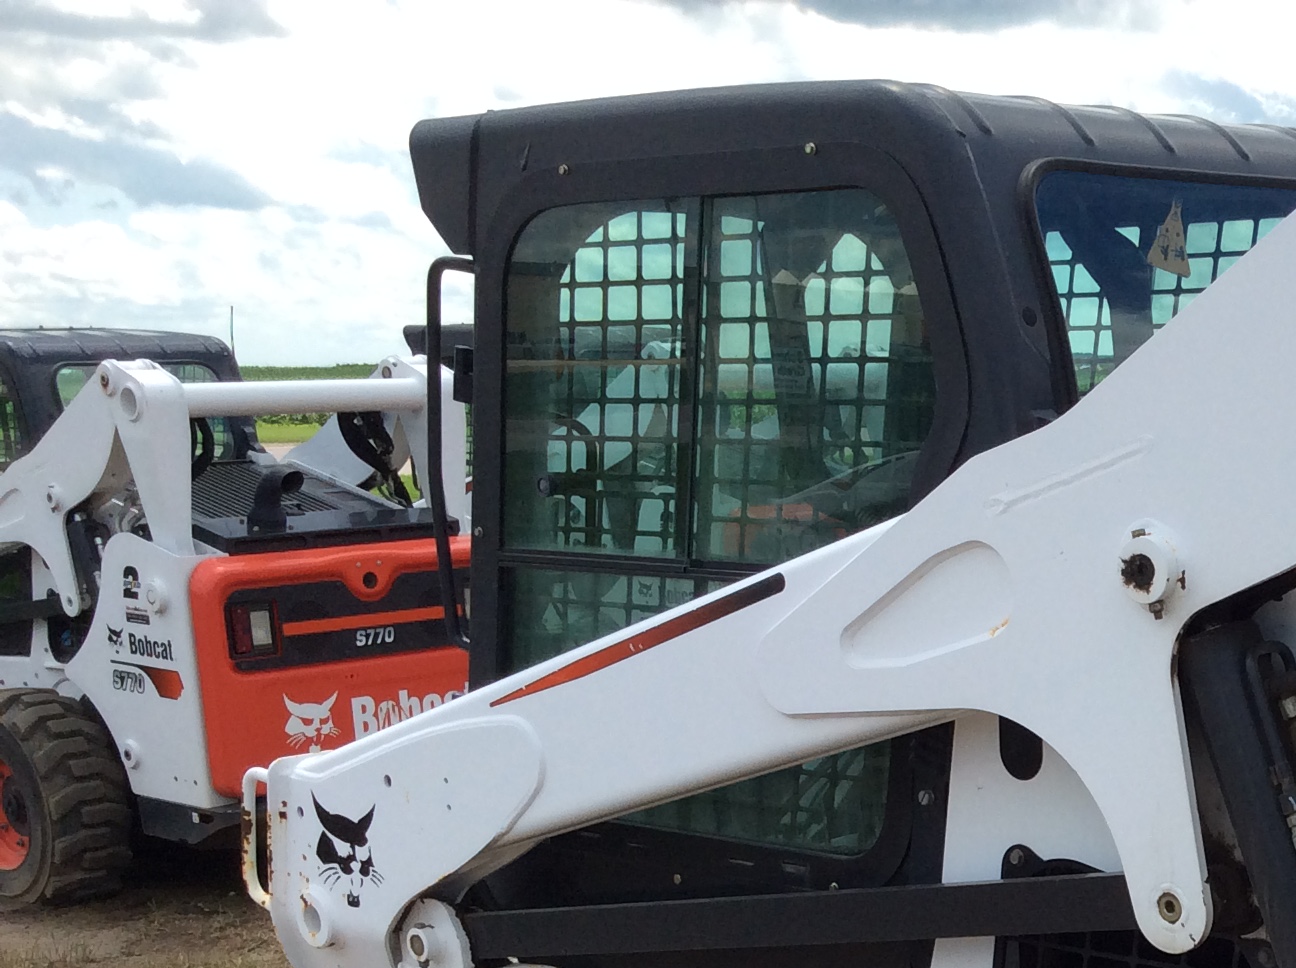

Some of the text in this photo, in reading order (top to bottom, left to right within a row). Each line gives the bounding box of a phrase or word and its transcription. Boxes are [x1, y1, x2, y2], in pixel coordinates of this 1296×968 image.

[128, 633, 173, 661] Bobcat
[356, 626, 394, 646] S770
[113, 669, 145, 694] S770
